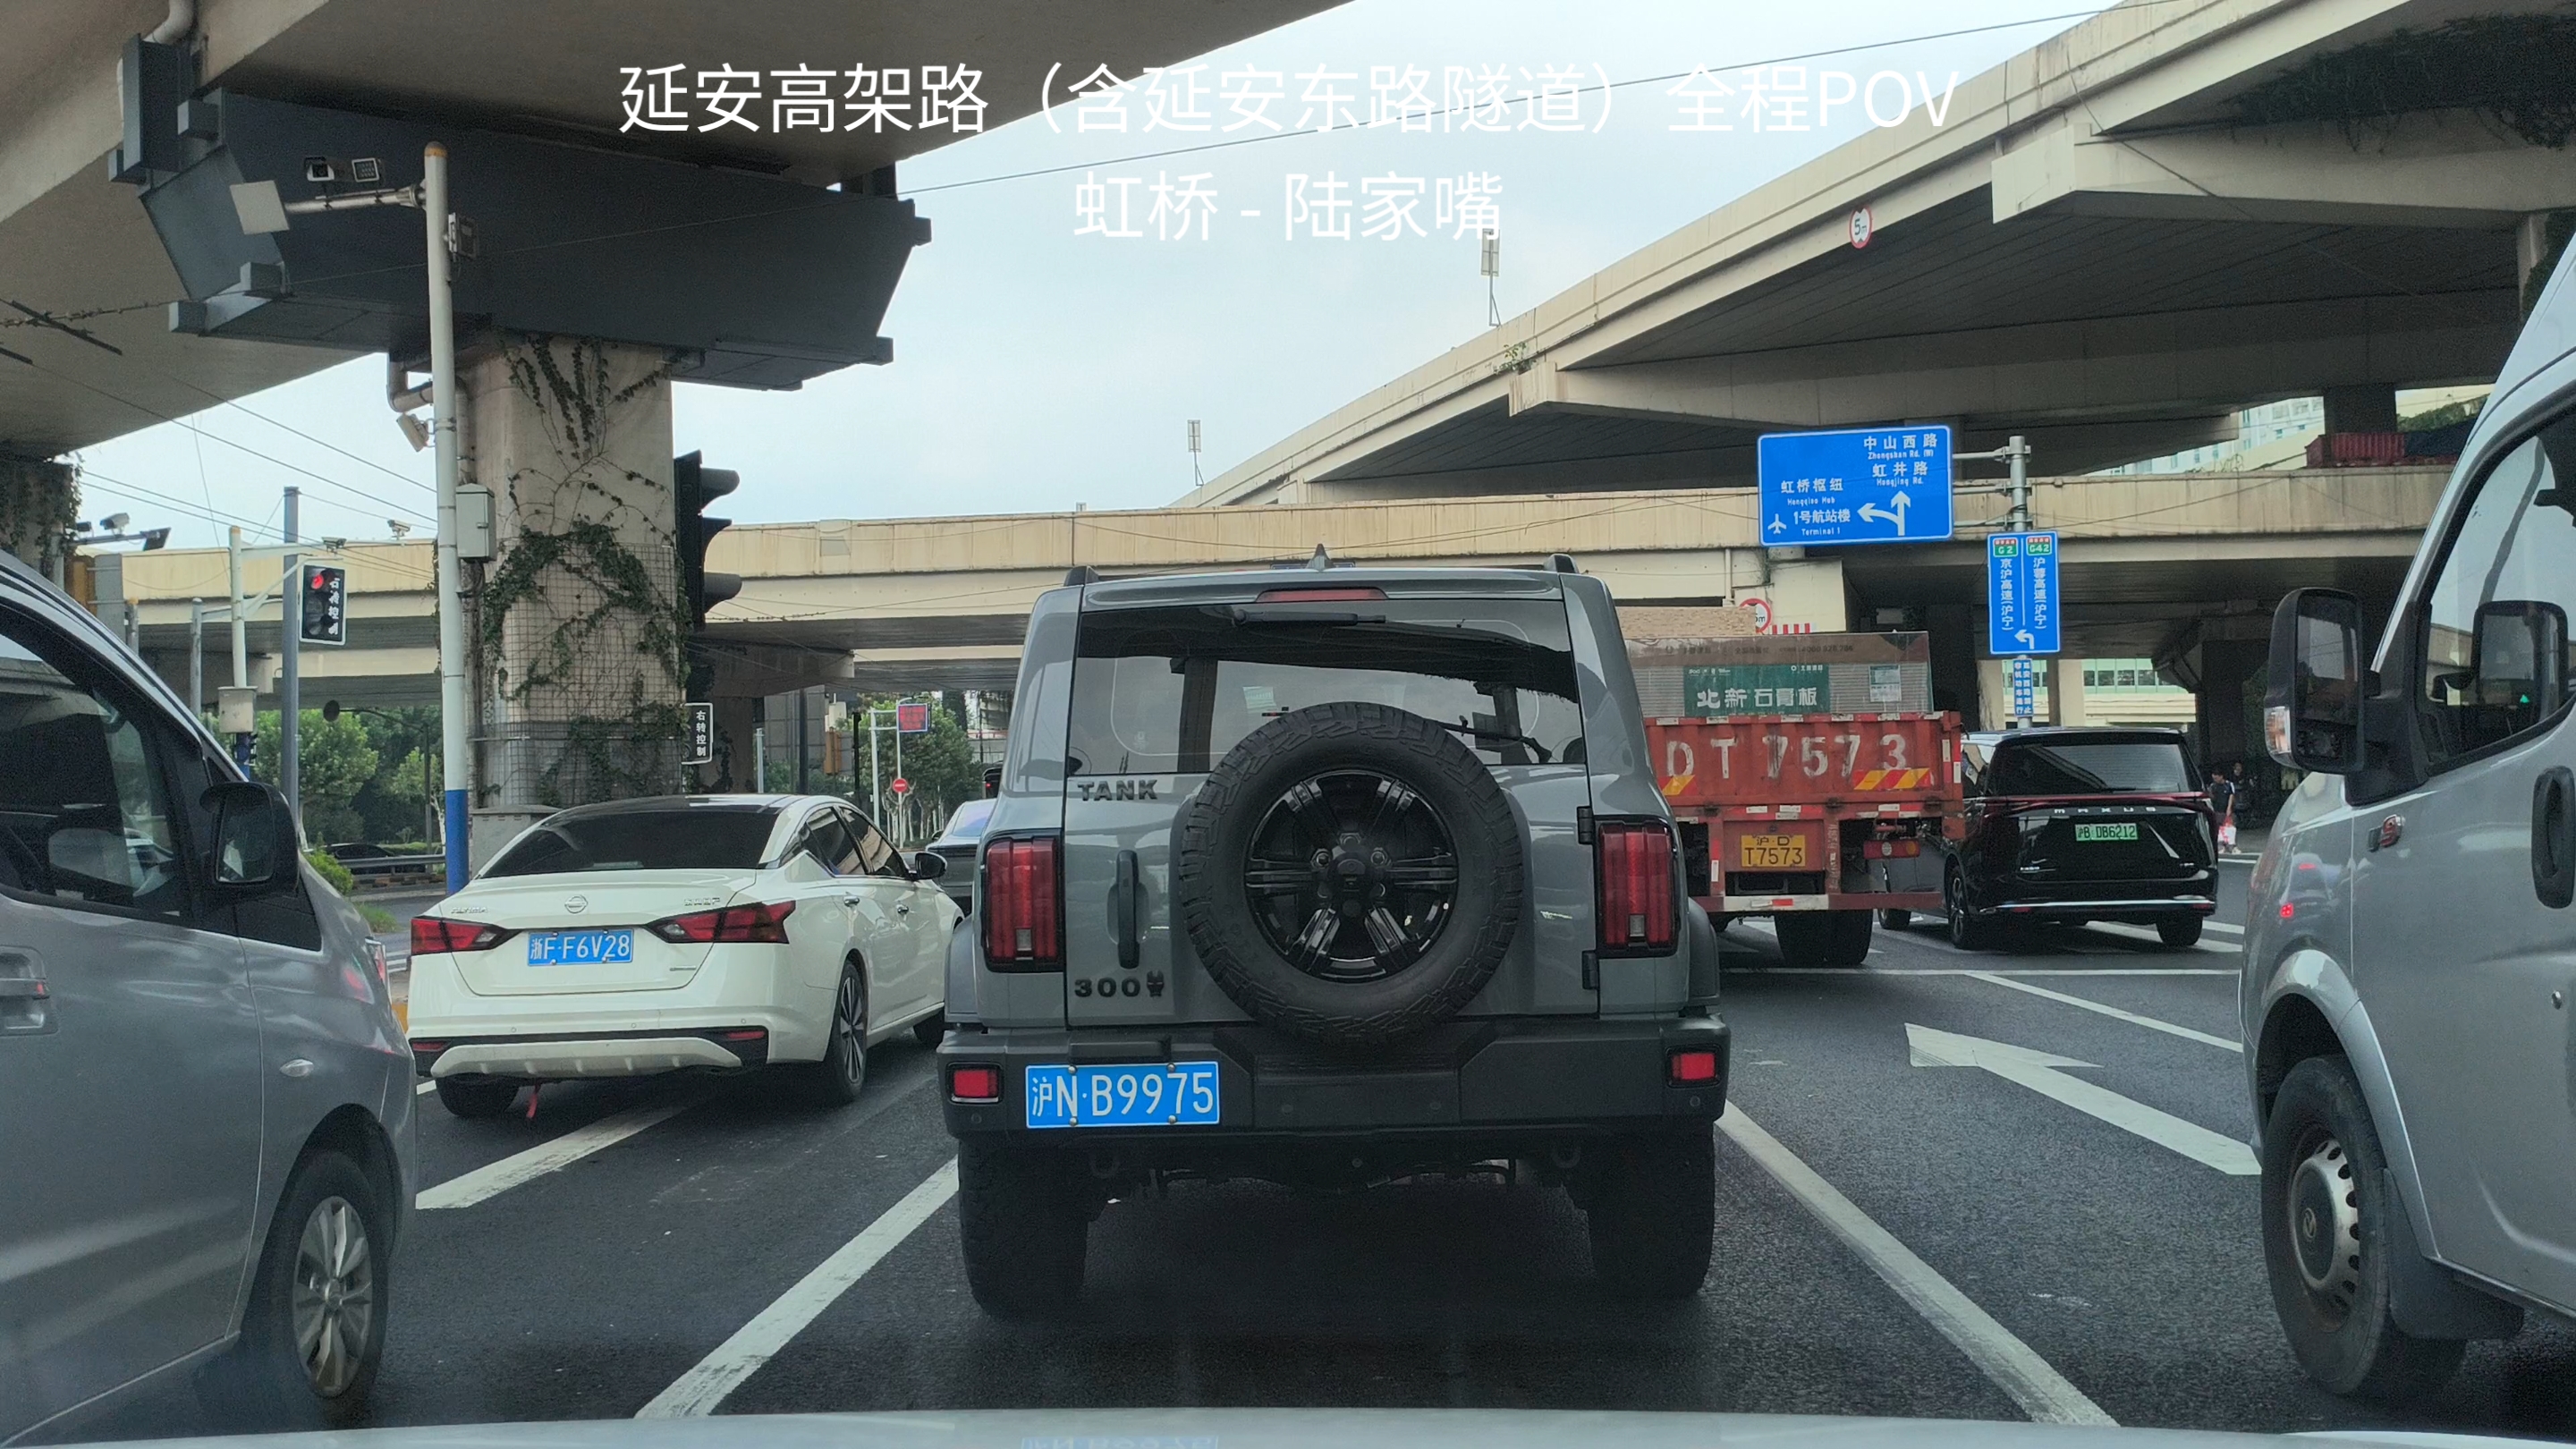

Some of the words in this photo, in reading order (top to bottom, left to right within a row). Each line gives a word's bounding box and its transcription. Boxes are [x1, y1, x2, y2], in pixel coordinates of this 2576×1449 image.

[1863, 433, 1937, 451] 中山西路
[1868, 451, 1907, 460] Zhongshan
[1872, 461, 1928, 478] 虹井路
[1781, 478, 1843, 494] 虹桥枢纽
[1876, 477, 1909, 487] Hongjing
[1787, 497, 1818, 506] Hongqiao
[1821, 496, 1835, 504] Hub
[1793, 508, 1852, 525] 1号航站楼
[1801, 527, 1835, 536] Terminal
[2029, 544, 2049, 553] G42
[1697, 687, 1818, 709] 北新石膏板
[696, 710, 707, 757] 右转控制
[1077, 779, 1158, 801] TANK
[1744, 847, 1803, 865] T7573
[1074, 977, 1141, 997] 300
